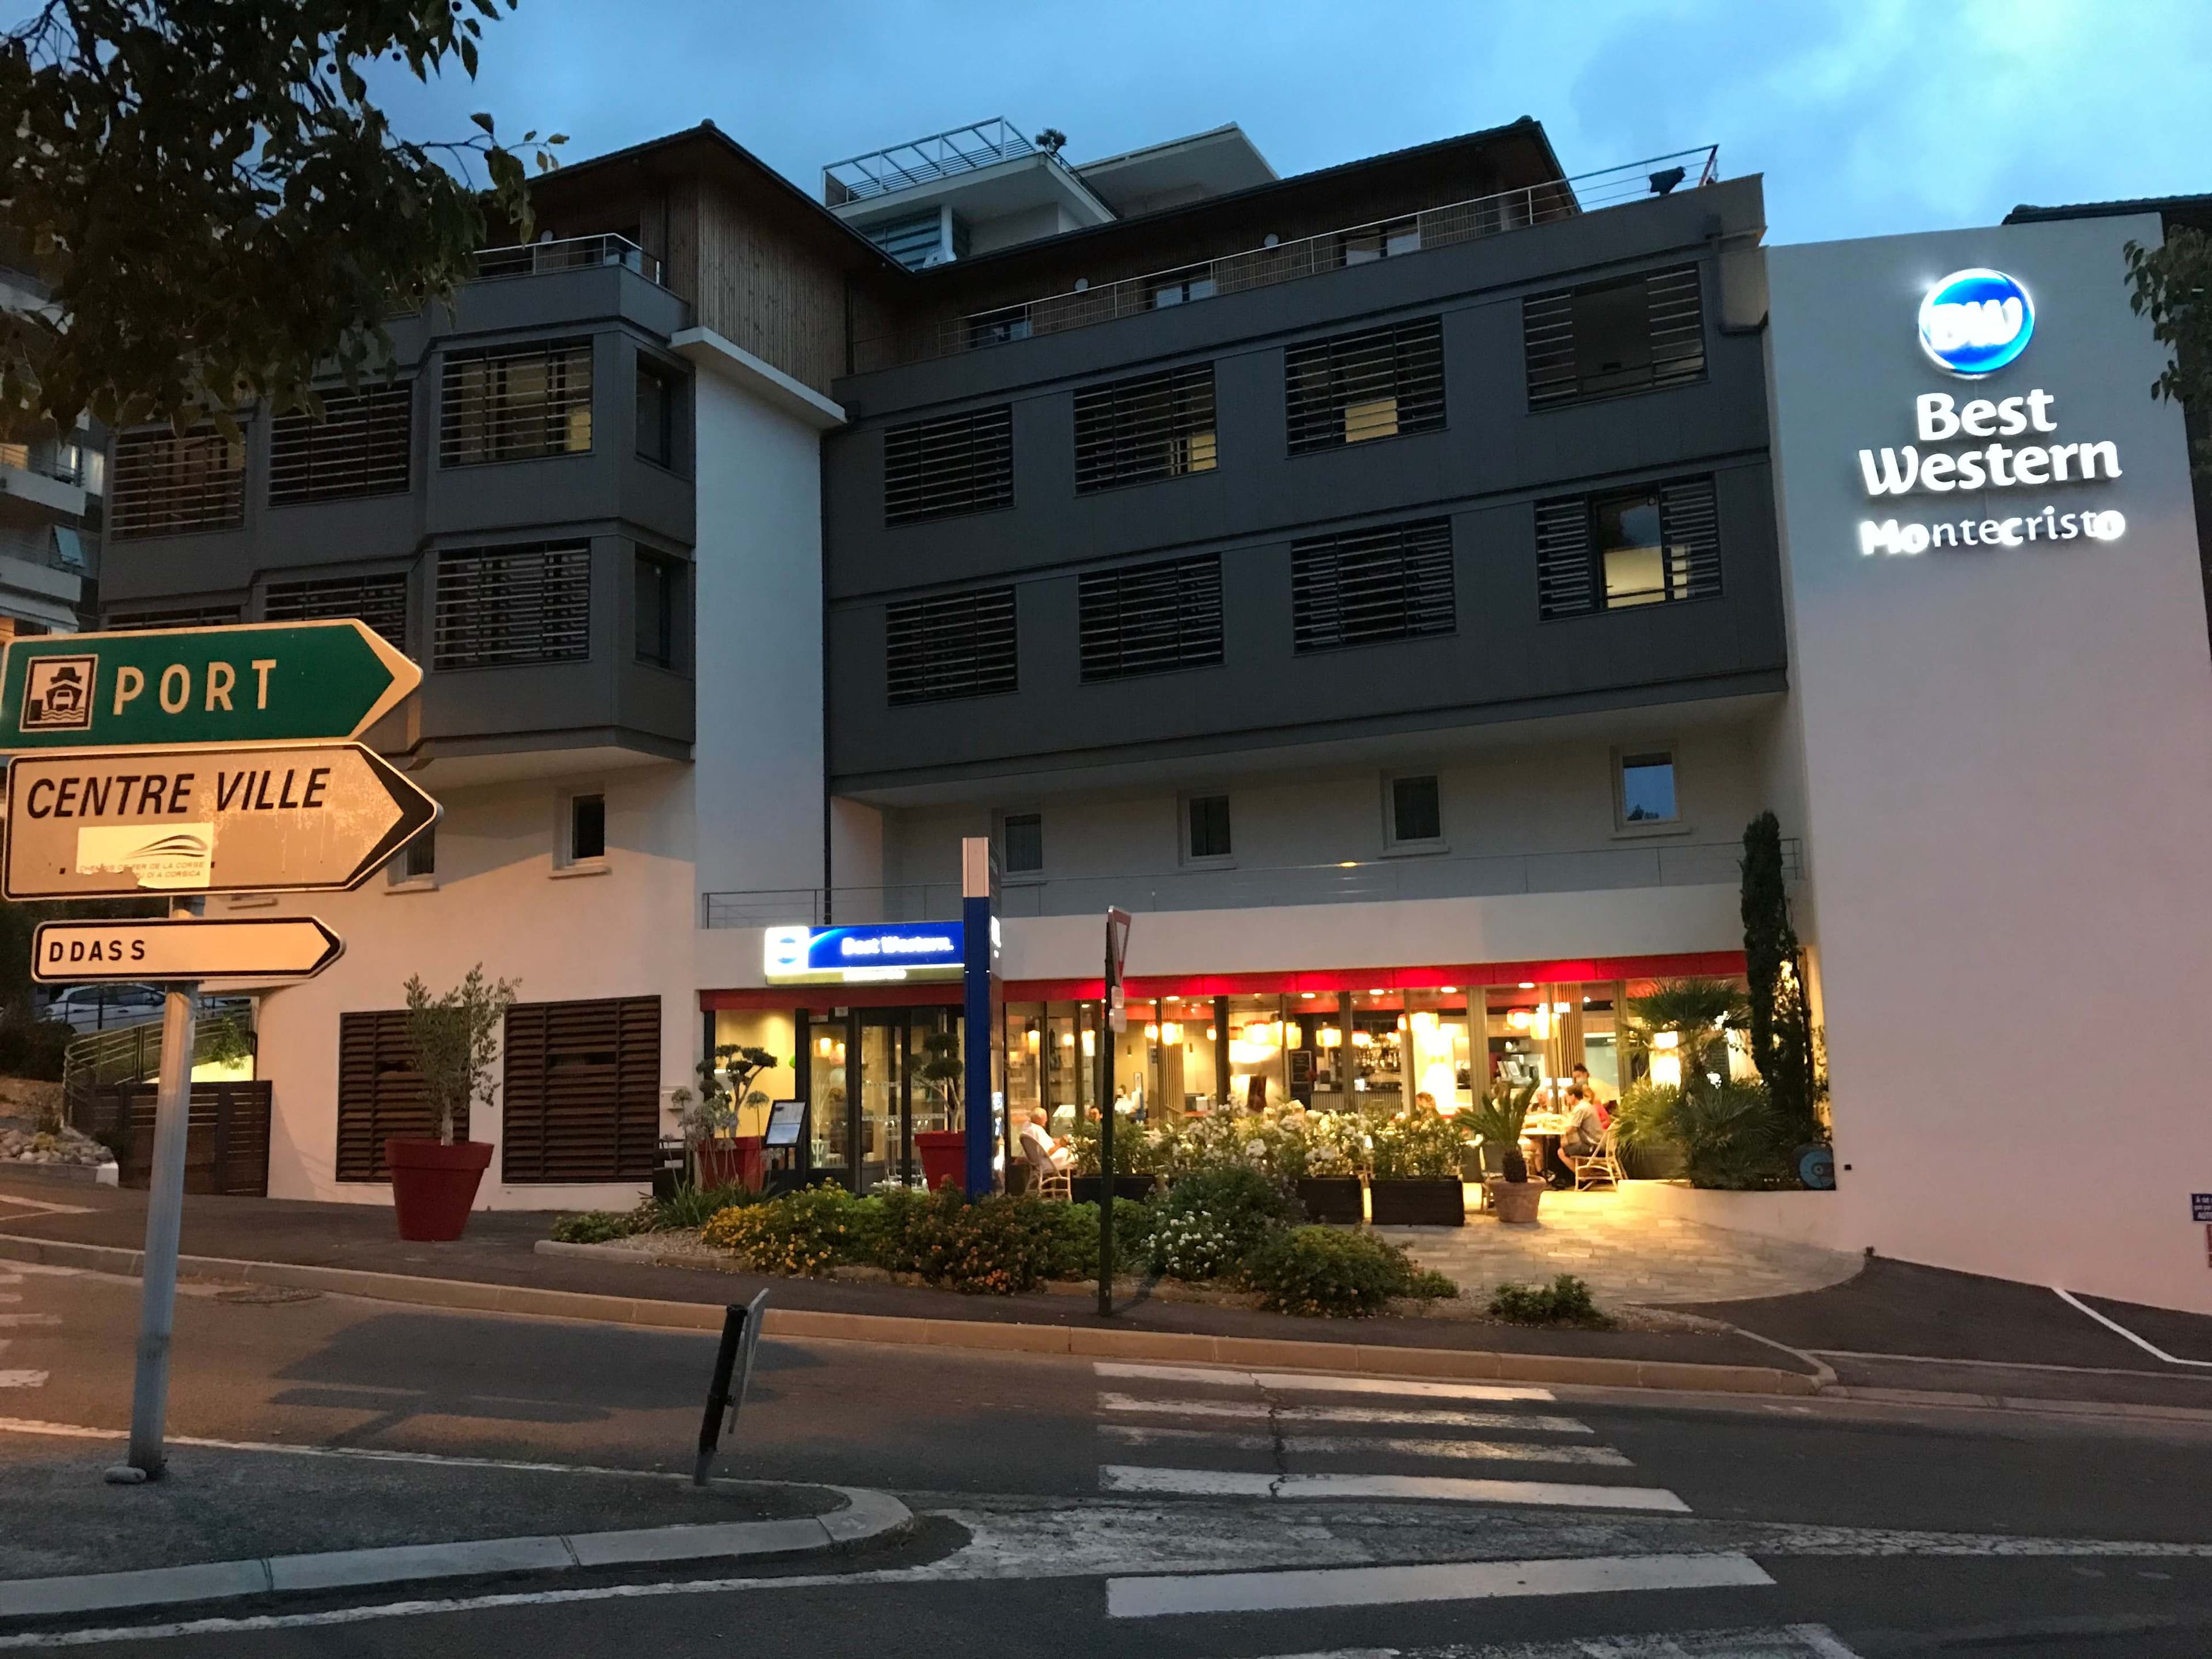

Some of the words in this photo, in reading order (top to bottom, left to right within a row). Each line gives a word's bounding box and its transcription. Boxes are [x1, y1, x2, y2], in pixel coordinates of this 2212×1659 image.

[1916, 388, 2058, 441] Best
[1858, 440, 2123, 496] Western
[1859, 505, 2126, 555] Montecristo
[112, 658, 277, 715] PORT
[26, 772, 195, 819] CENTRE
[215, 767, 331, 812] VILLE
[49, 939, 146, 963] DDASS
